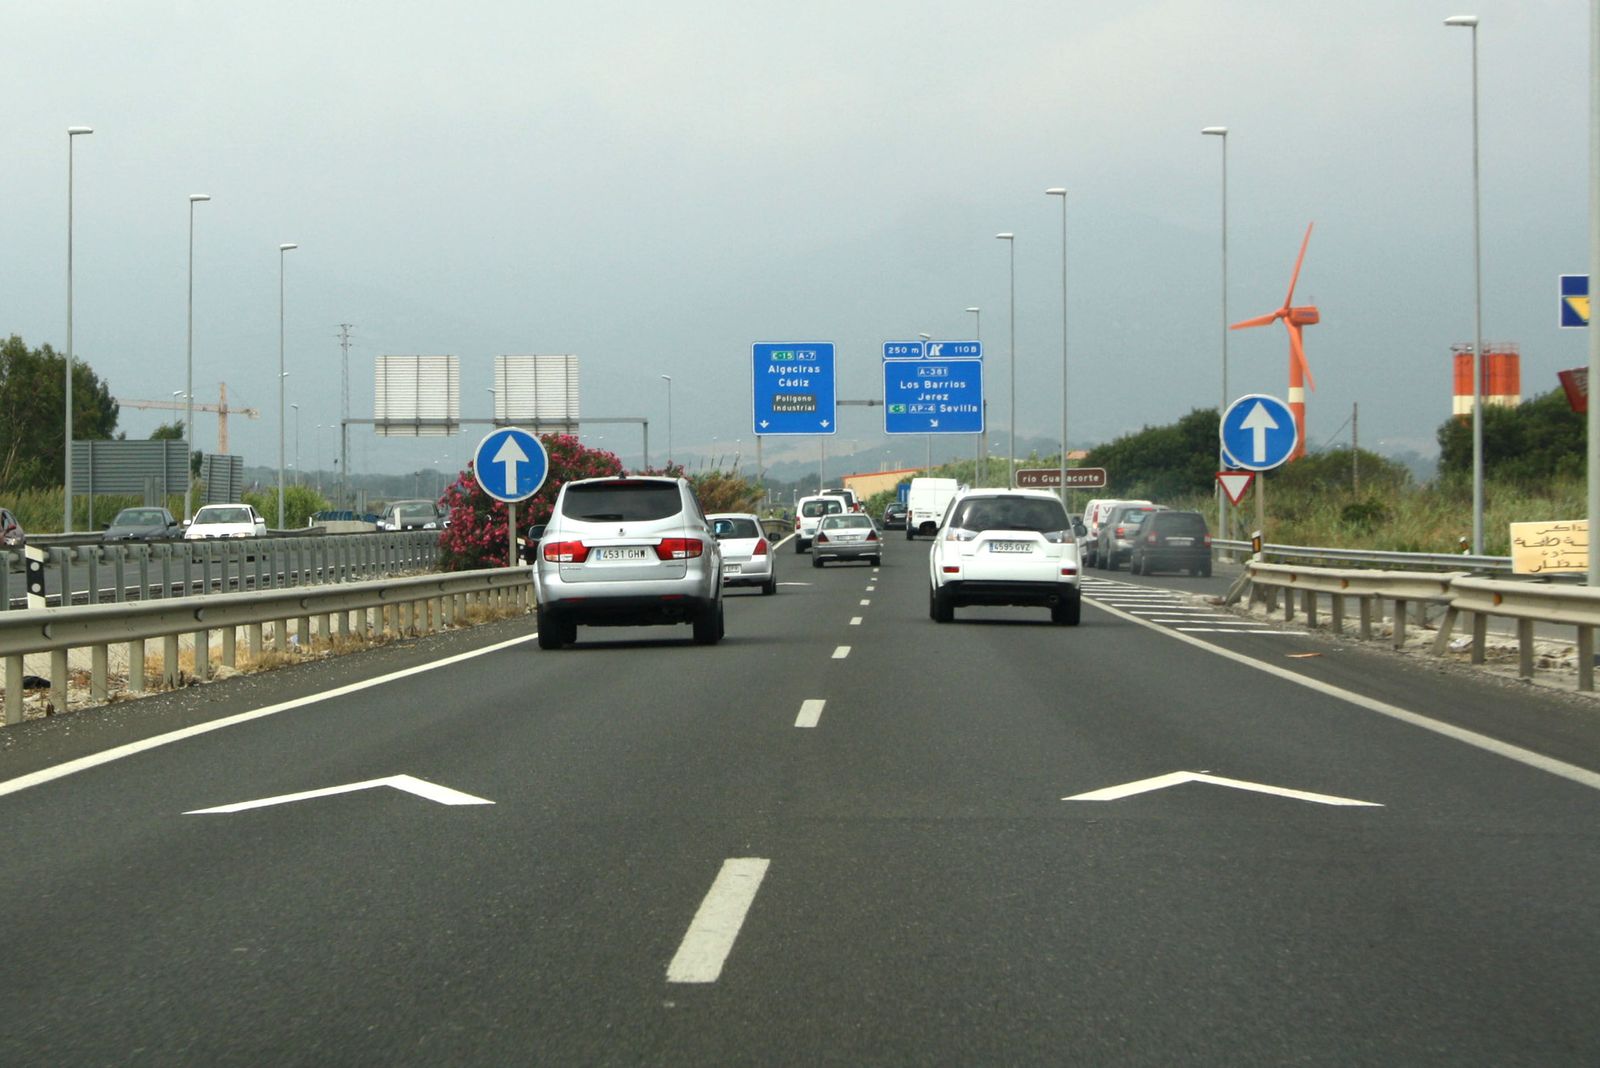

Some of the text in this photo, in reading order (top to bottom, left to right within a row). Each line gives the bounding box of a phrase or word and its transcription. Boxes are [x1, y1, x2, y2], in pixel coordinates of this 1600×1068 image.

[888, 346, 907, 354] 250
[798, 352, 815, 360] A-7
[768, 364, 821, 375] Algeciras
[778, 378, 809, 387] Cádiz
[900, 380, 966, 389] Los Barrios
[918, 392, 949, 401] Jerez
[910, 404, 935, 412] AP-4
[940, 404, 978, 413] Sevilla
[1041, 474, 1099, 483] Guaacorte
[994, 543, 1032, 551] 4595 GVZ
[602, 549, 646, 559] 4531 GHW
